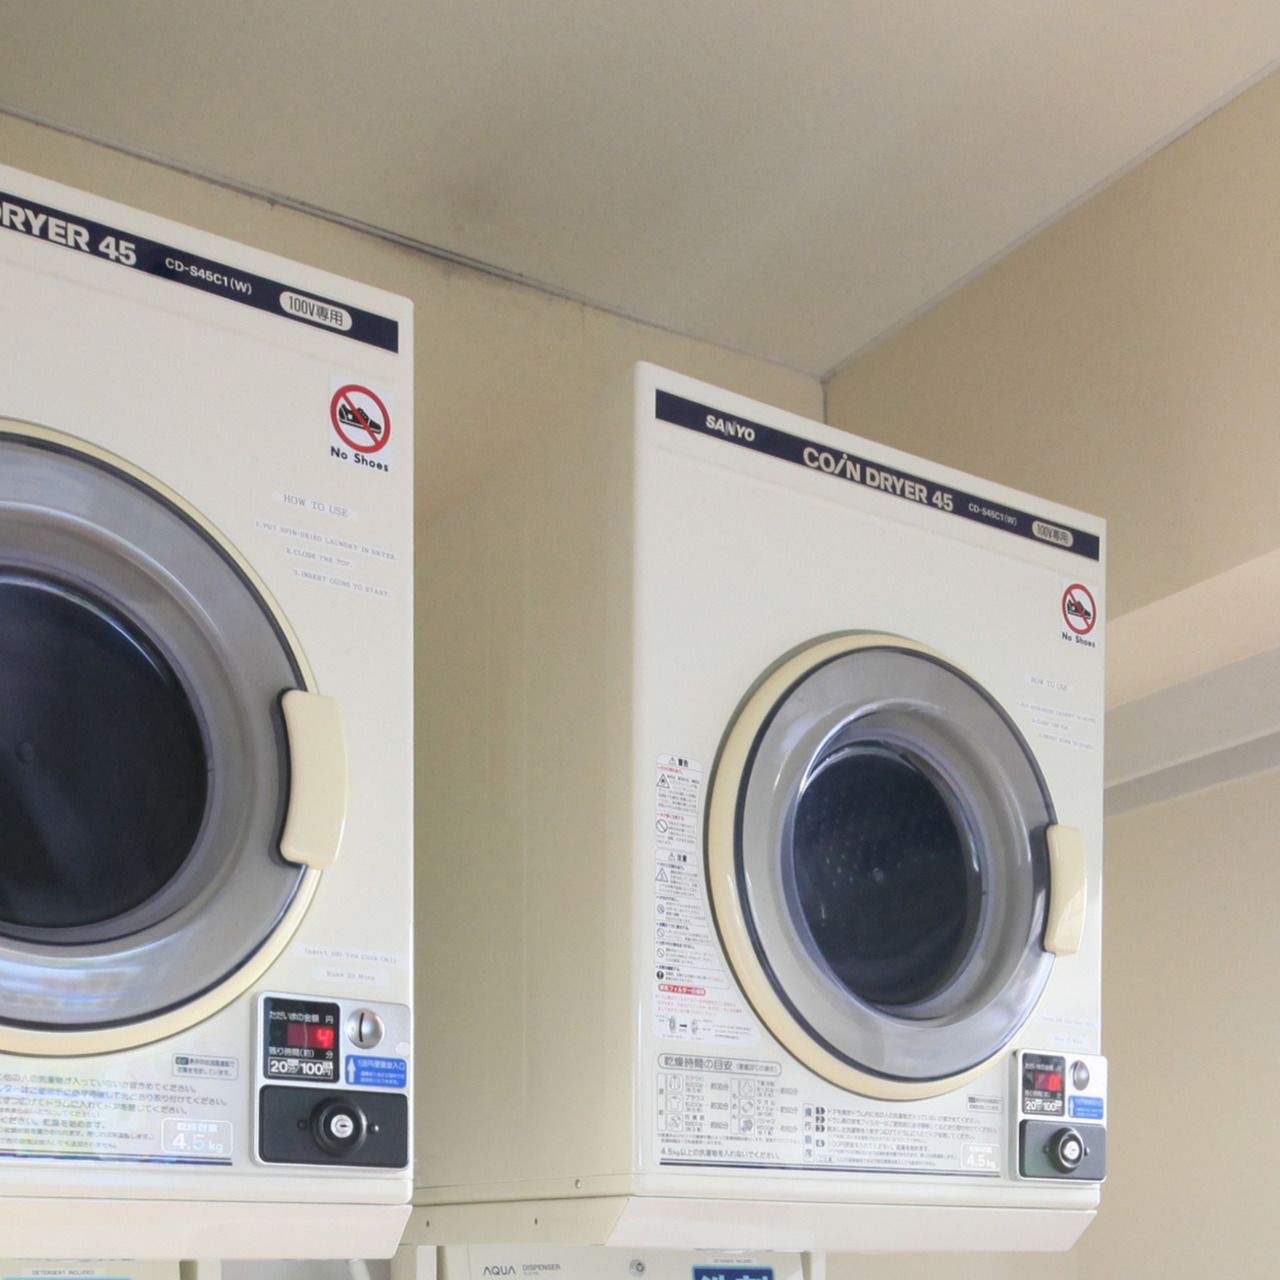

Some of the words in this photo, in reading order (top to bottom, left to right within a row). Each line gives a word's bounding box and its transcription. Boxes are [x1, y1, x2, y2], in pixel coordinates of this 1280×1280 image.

[98, 235, 138, 266] 45
[165, 257, 252, 295] CD-S45C1(W)
[288, 295, 343, 327] 100V専用
[705, 414, 756, 441] SANYO
[330, 445, 348, 461] No
[353, 453, 389, 473] Shoes
[866, 469, 928, 502] DRYER
[932, 490, 954, 512] 45
[283, 493, 306, 507] HOW
[311, 501, 326, 513] TO
[329, 506, 349, 518] USE
[1062, 632, 1072, 642] No
[1075, 636, 1096, 648] Shoes
[483, 1266, 516, 1276] AQUA
